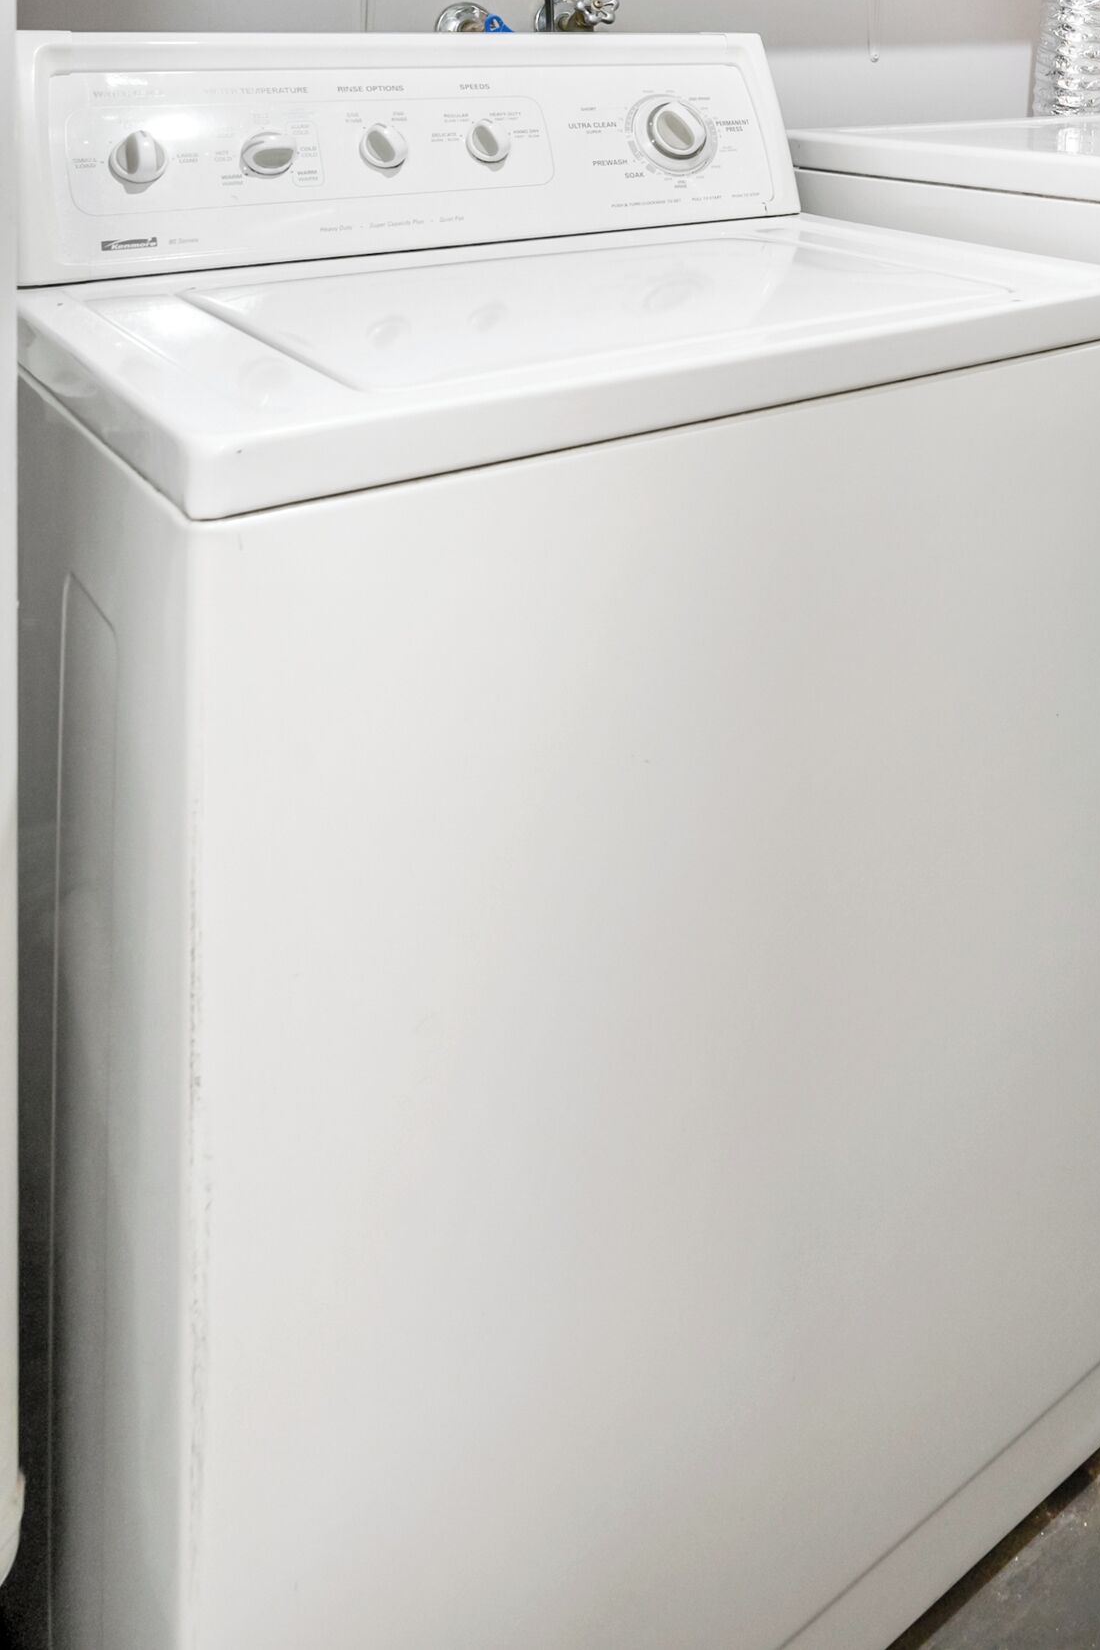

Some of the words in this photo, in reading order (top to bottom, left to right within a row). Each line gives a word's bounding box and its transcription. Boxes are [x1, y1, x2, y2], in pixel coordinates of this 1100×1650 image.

[337, 85, 363, 93] RINSE
[459, 83, 490, 91] SPEEDS
[592, 159, 628, 167] PREWASH
[110, 237, 157, 250] Kenmore
